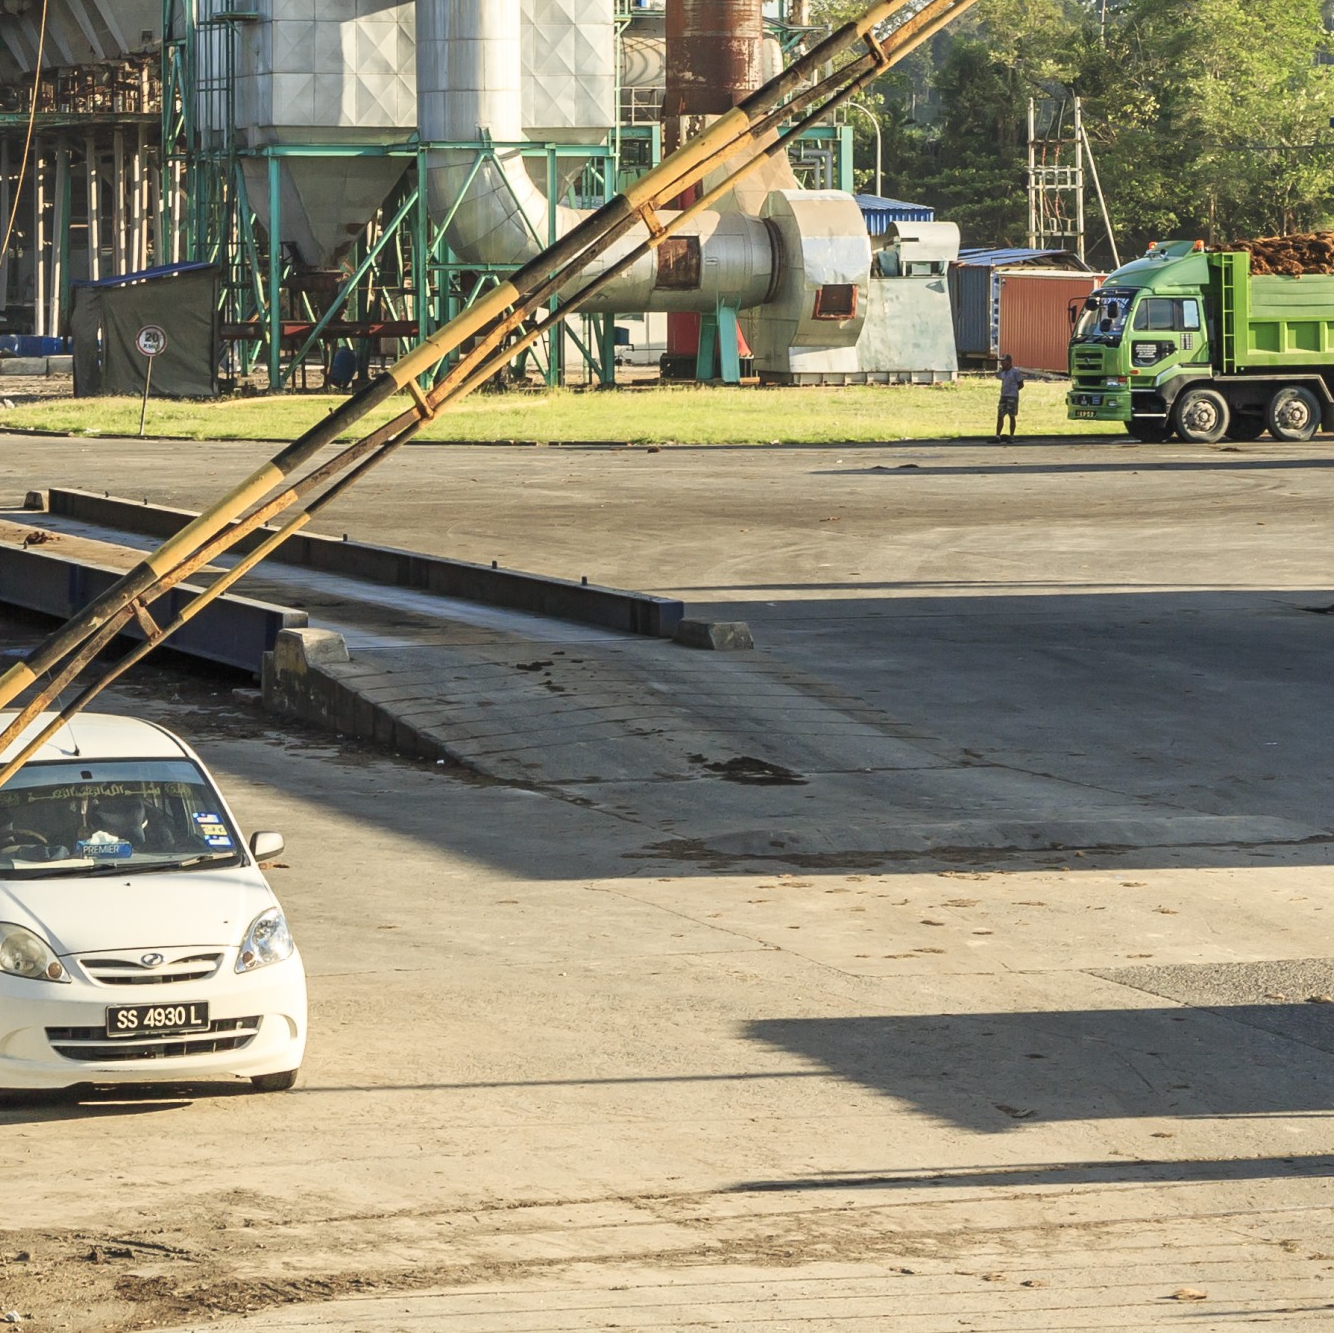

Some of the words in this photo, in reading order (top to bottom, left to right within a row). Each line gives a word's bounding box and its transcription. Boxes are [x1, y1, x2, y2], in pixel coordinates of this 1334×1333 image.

[145, 332, 159, 342] 20
[83, 845, 119, 854] PREMIER
[117, 1009, 138, 1028] SS
[143, 1006, 185, 1027] 4930
[191, 1006, 202, 1024] L
